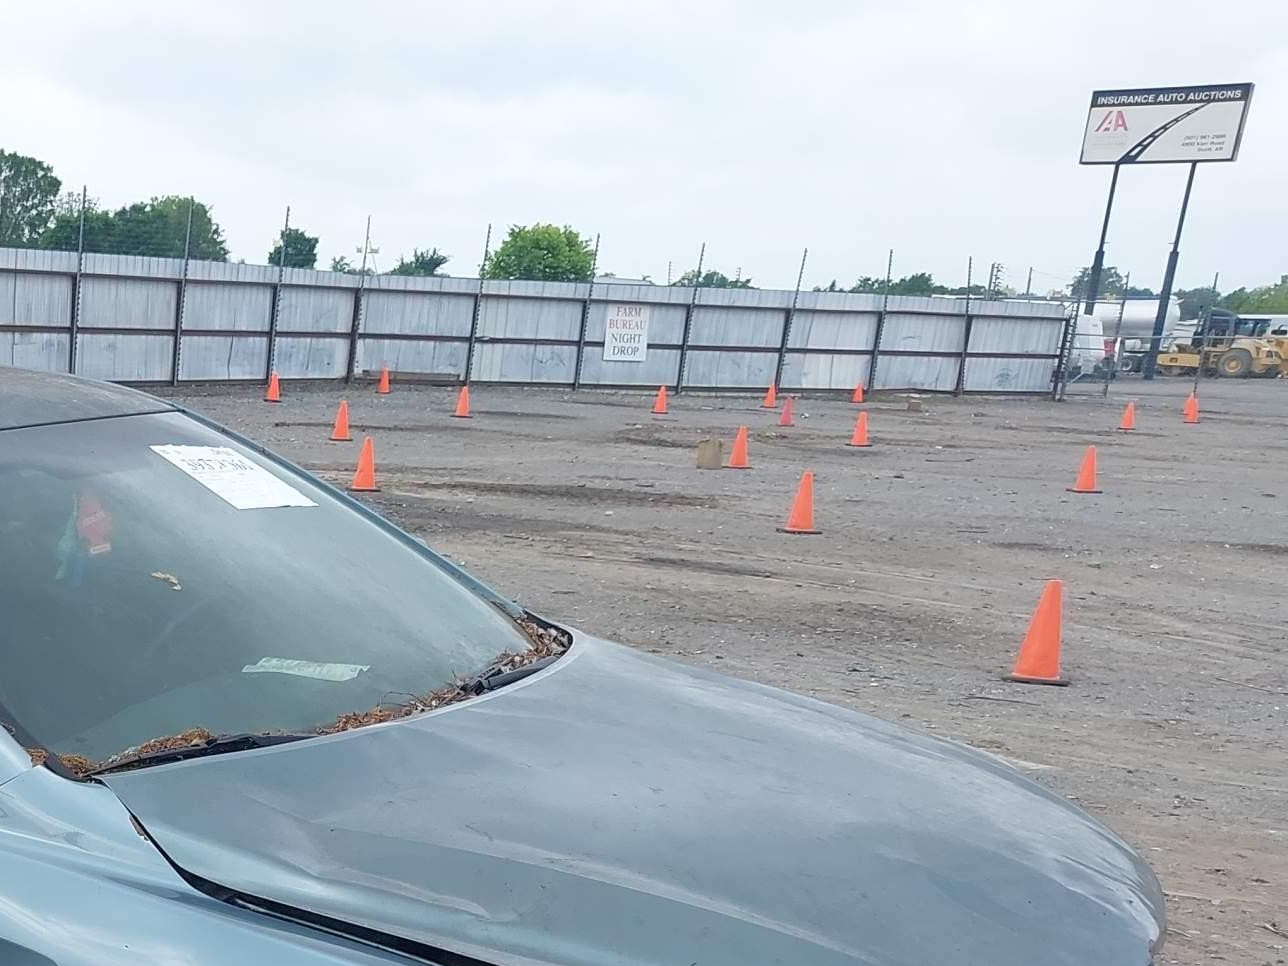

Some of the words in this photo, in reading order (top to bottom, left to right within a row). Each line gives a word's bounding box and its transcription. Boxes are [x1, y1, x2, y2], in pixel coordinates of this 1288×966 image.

[1097, 94, 1155, 105] INSURANCE
[1157, 92, 1186, 102] AUTO
[1187, 90, 1242, 101] AUCTIONS
[616, 306, 642, 317] FARM
[609, 319, 646, 330] BUREAU
[611, 333, 643, 344] NIGHT
[612, 345, 640, 356] DROP
